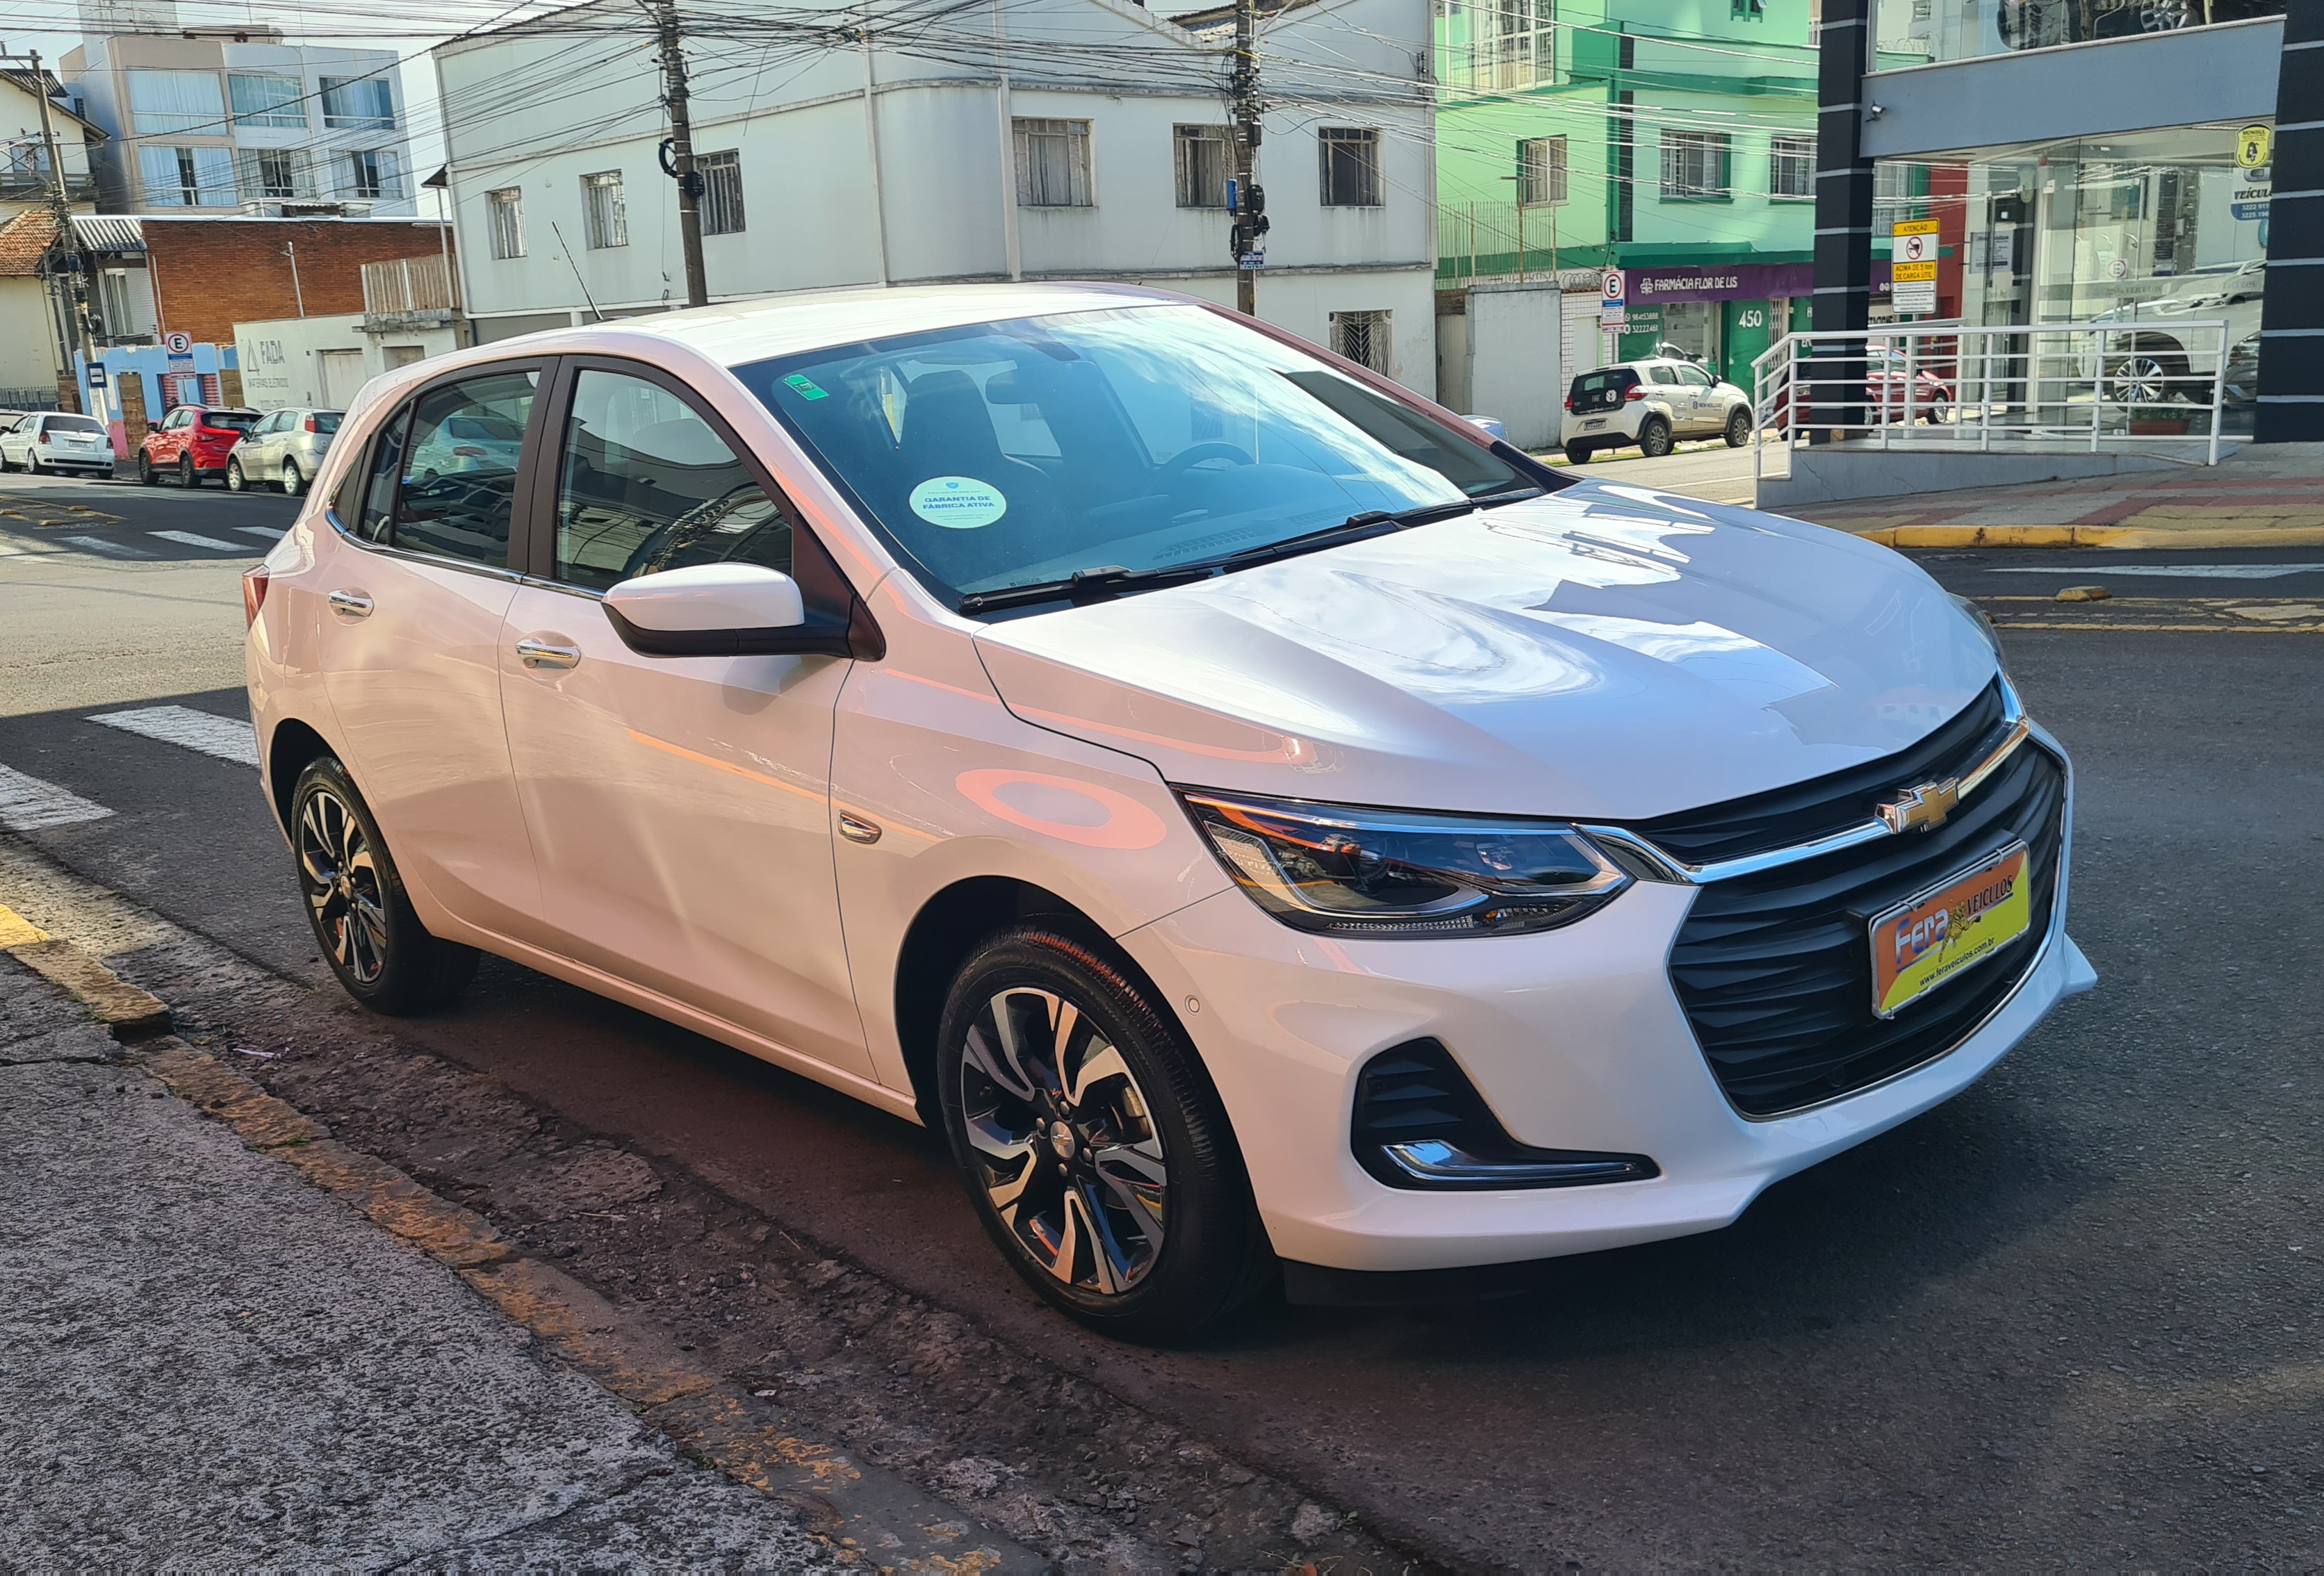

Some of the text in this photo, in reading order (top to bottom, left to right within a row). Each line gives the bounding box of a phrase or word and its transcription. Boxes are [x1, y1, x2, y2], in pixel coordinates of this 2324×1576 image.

[2234, 187, 2272, 200] VEÍCUL
[1903, 223, 1927, 233] ATENÇÃO
[1609, 279, 1617, 293] E
[1654, 275, 1738, 291] FARMÁCIA FLOR DE LIS
[1738, 309, 1762, 328] 450
[174, 338, 183, 350] E
[259, 340, 286, 364] FADA
[1895, 907, 1949, 965] Fera
[1919, 936, 1995, 987] www.feraveiculos.com.br
